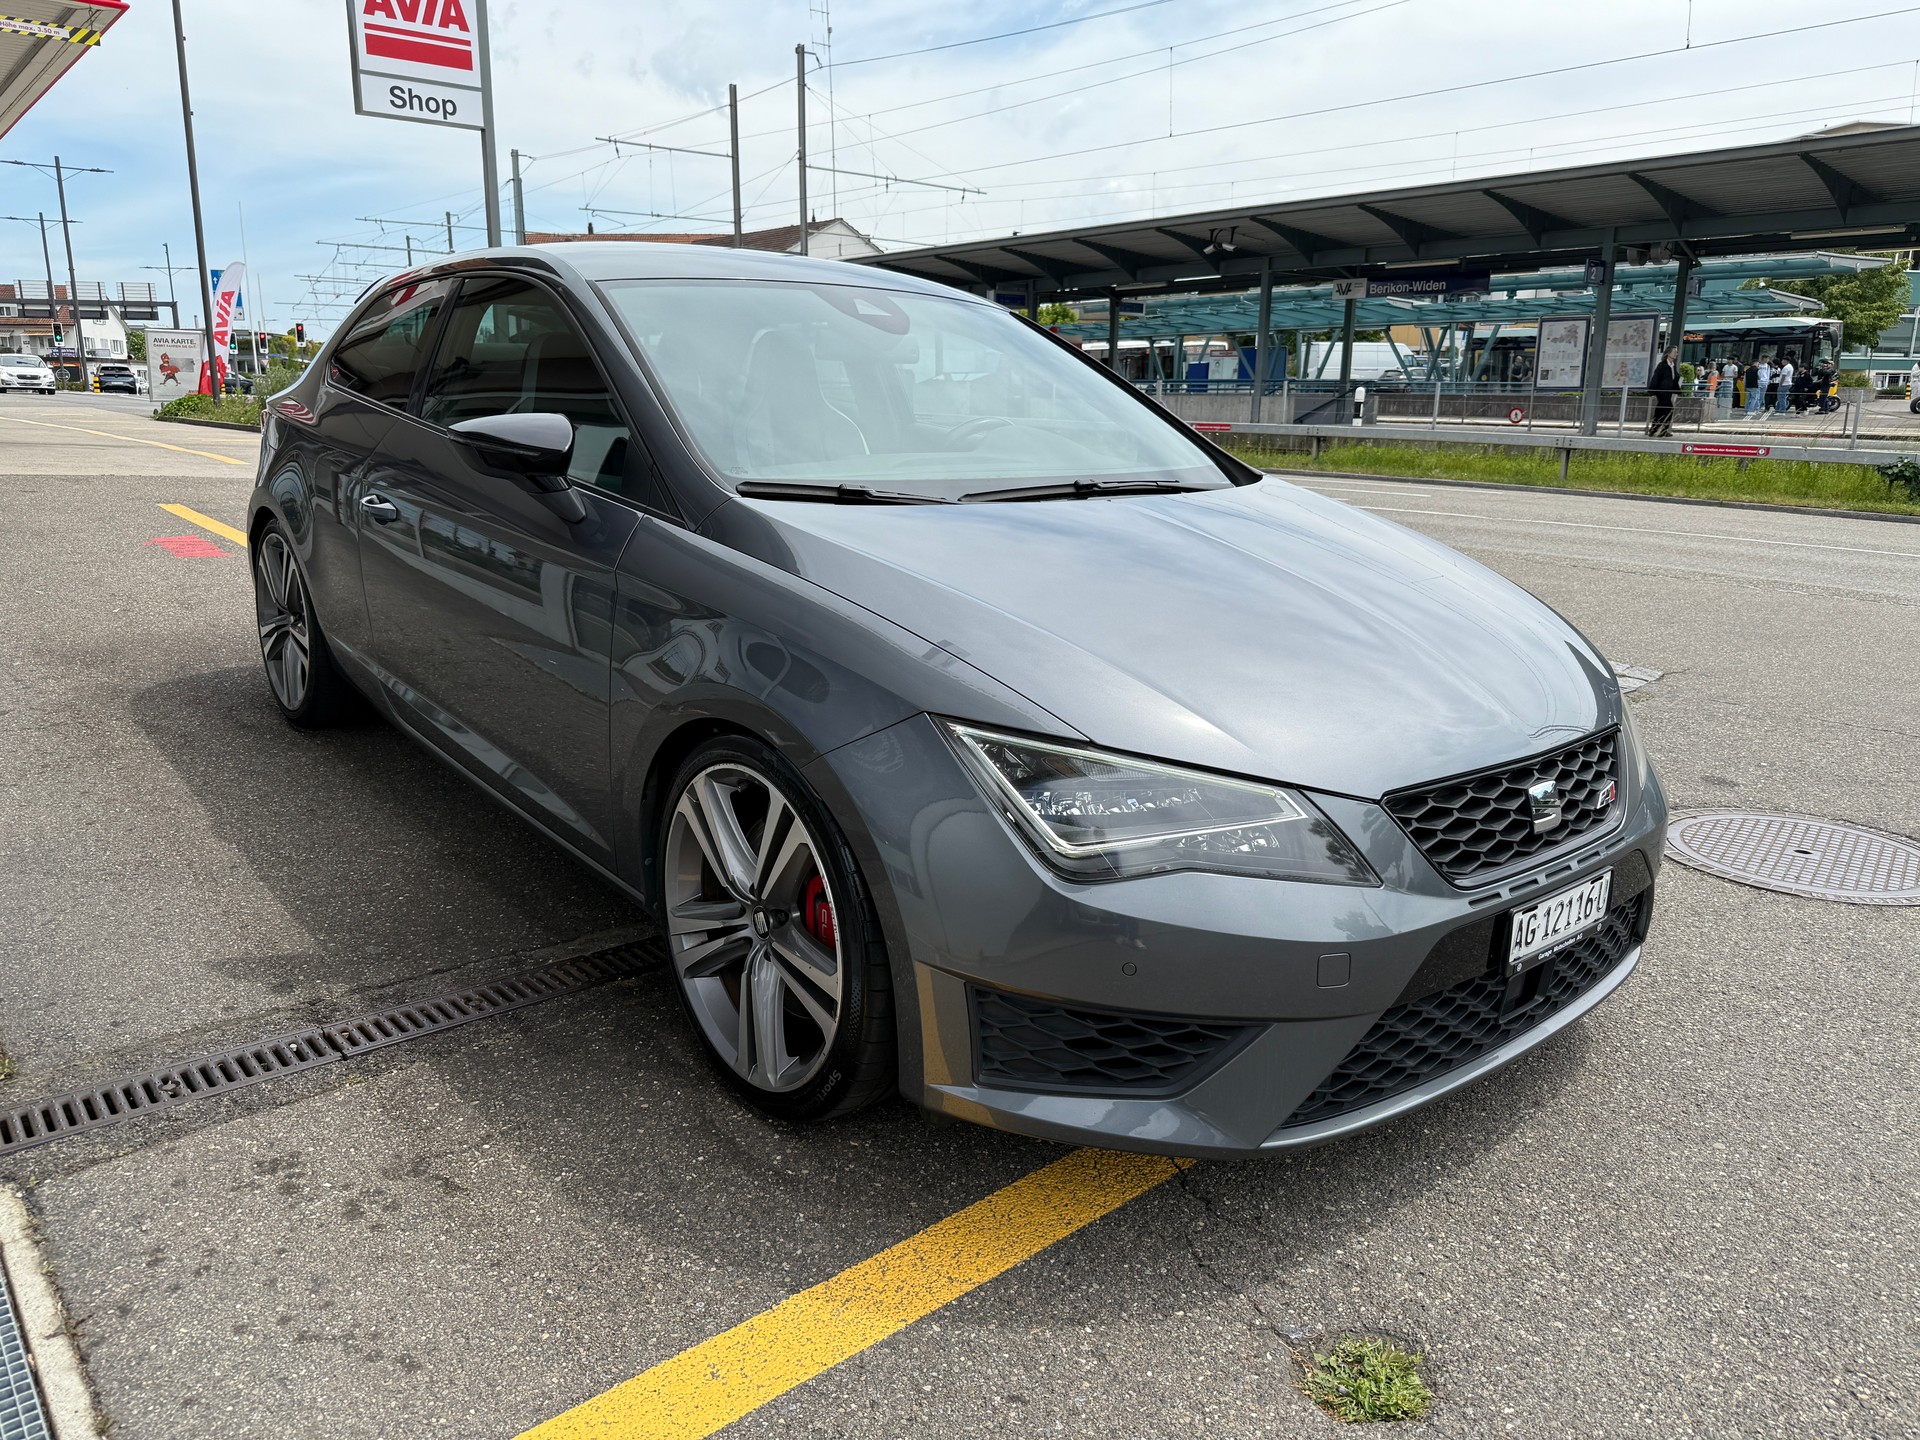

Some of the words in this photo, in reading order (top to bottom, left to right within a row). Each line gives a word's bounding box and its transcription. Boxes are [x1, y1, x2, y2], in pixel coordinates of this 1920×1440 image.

[363, 0, 471, 33] AVIA
[389, 85, 457, 120] Shop
[1369, 280, 1447, 294] Berikon-Widen
[1590, 267, 1597, 280] 2
[213, 290, 236, 347] AVIA
